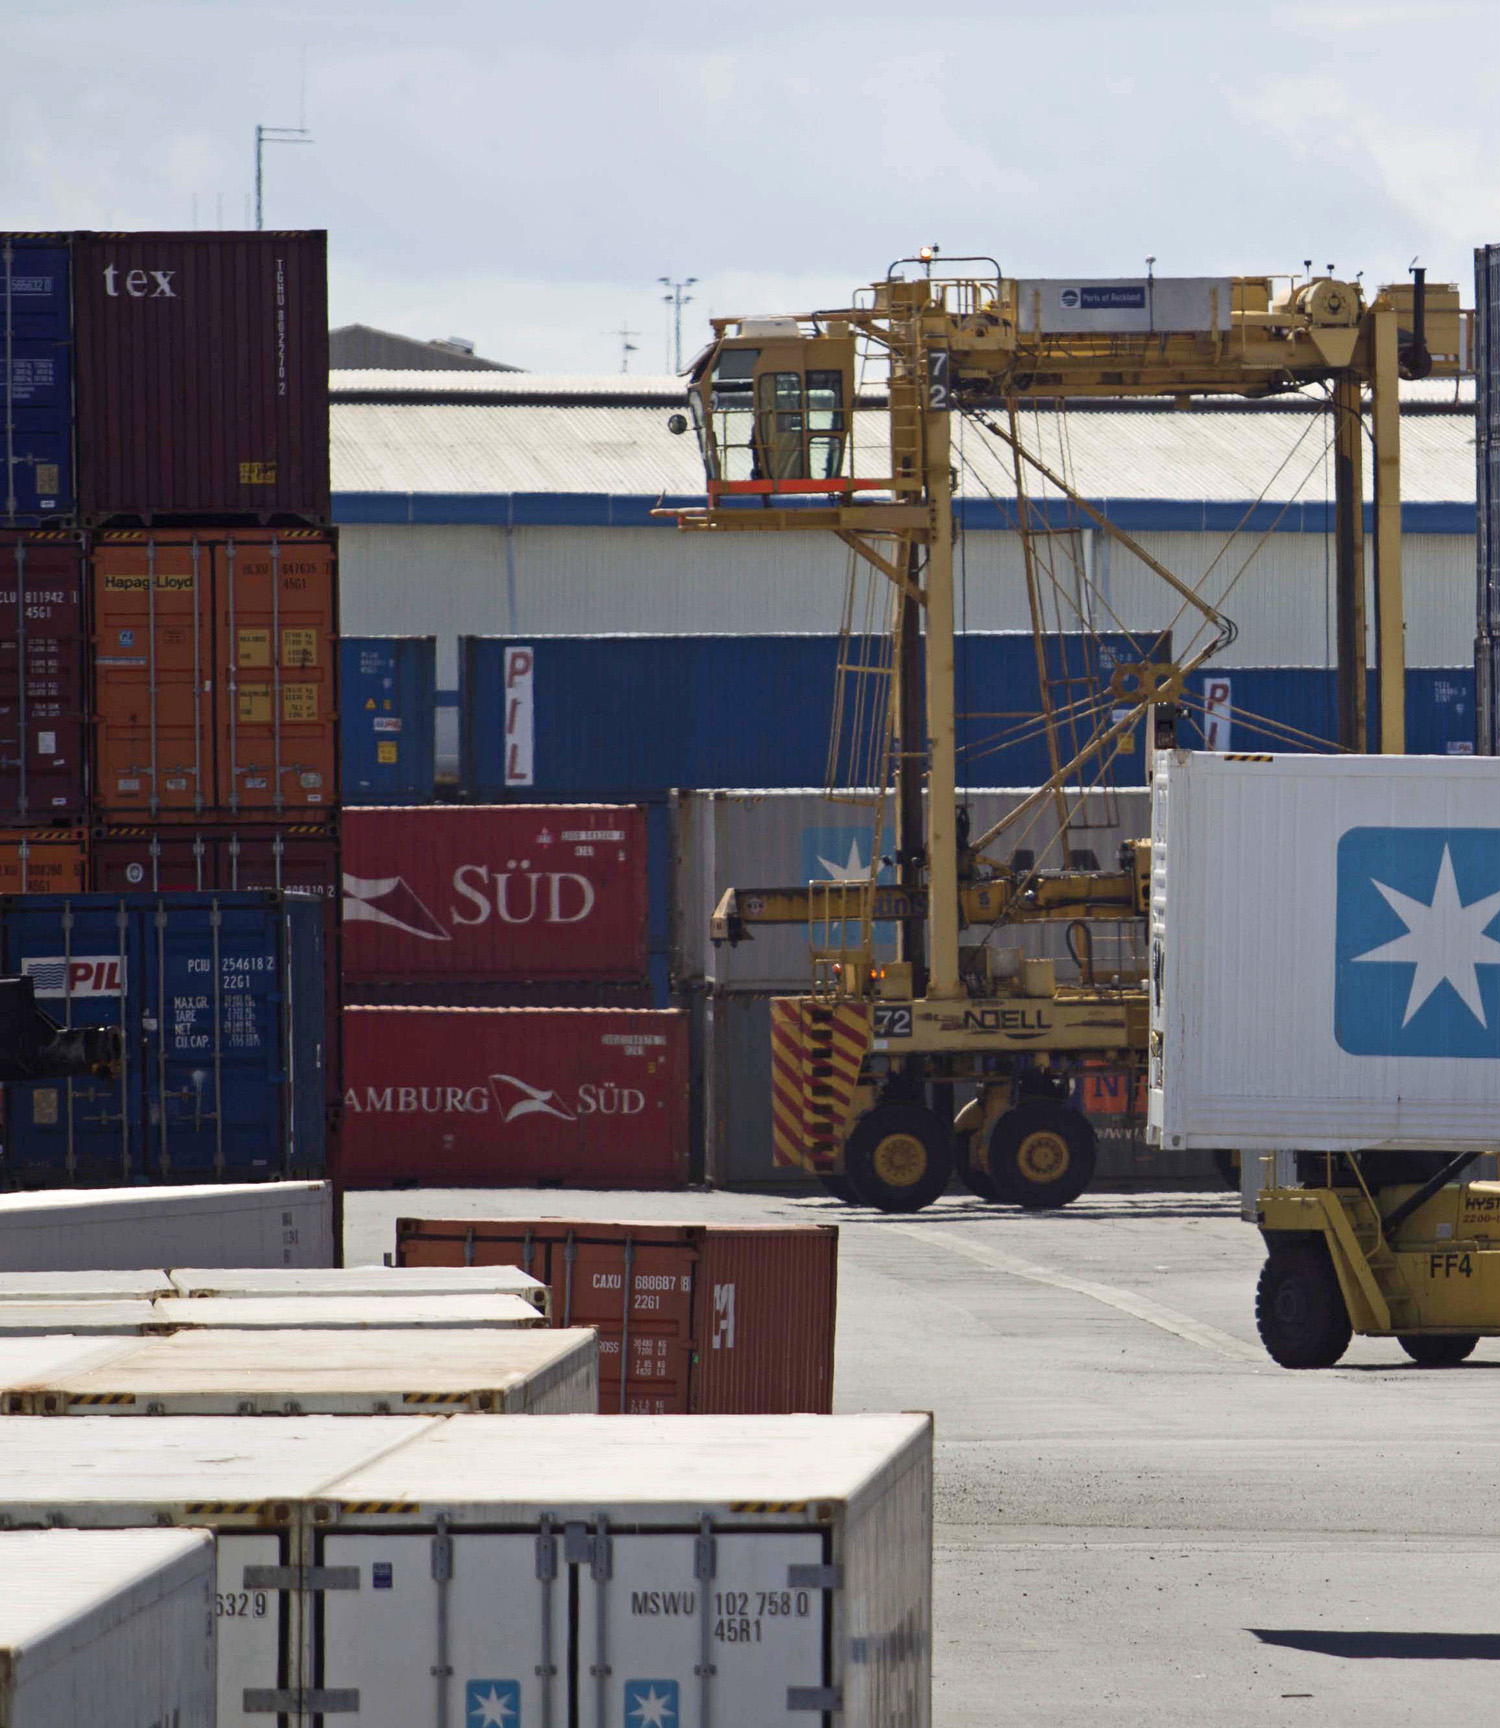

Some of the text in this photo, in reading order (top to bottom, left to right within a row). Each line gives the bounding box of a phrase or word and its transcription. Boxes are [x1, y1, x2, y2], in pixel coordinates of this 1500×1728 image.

[103, 262, 177, 297] tex
[105, 576, 194, 590] Hapag-Lloyd
[25, 591, 64, 604] 811942
[26, 606, 51, 619] 45G1
[506, 651, 533, 781] PIL
[451, 859, 595, 926] SÜD
[187, 956, 275, 972] PCIU 254618 2
[68, 962, 122, 991] PIL
[223, 975, 250, 989] 22G1
[175, 1010, 197, 1022] TARE
[875, 1010, 911, 1034] 72
[964, 1010, 1052, 1030] NOELL
[175, 1022, 191, 1035] NET
[345, 1082, 645, 1114] AMBURG SÜD
[1430, 1253, 1473, 1278] FF4
[593, 1273, 621, 1289] CAXU
[634, 1294, 660, 1309] 22G1
[215, 1592, 266, 1617] 632 9
[632, 1591, 695, 1616] MSWU
[715, 1591, 748, 1616] 102
[757, 1591, 790, 1616] 758
[715, 1619, 763, 1643] 45R1
